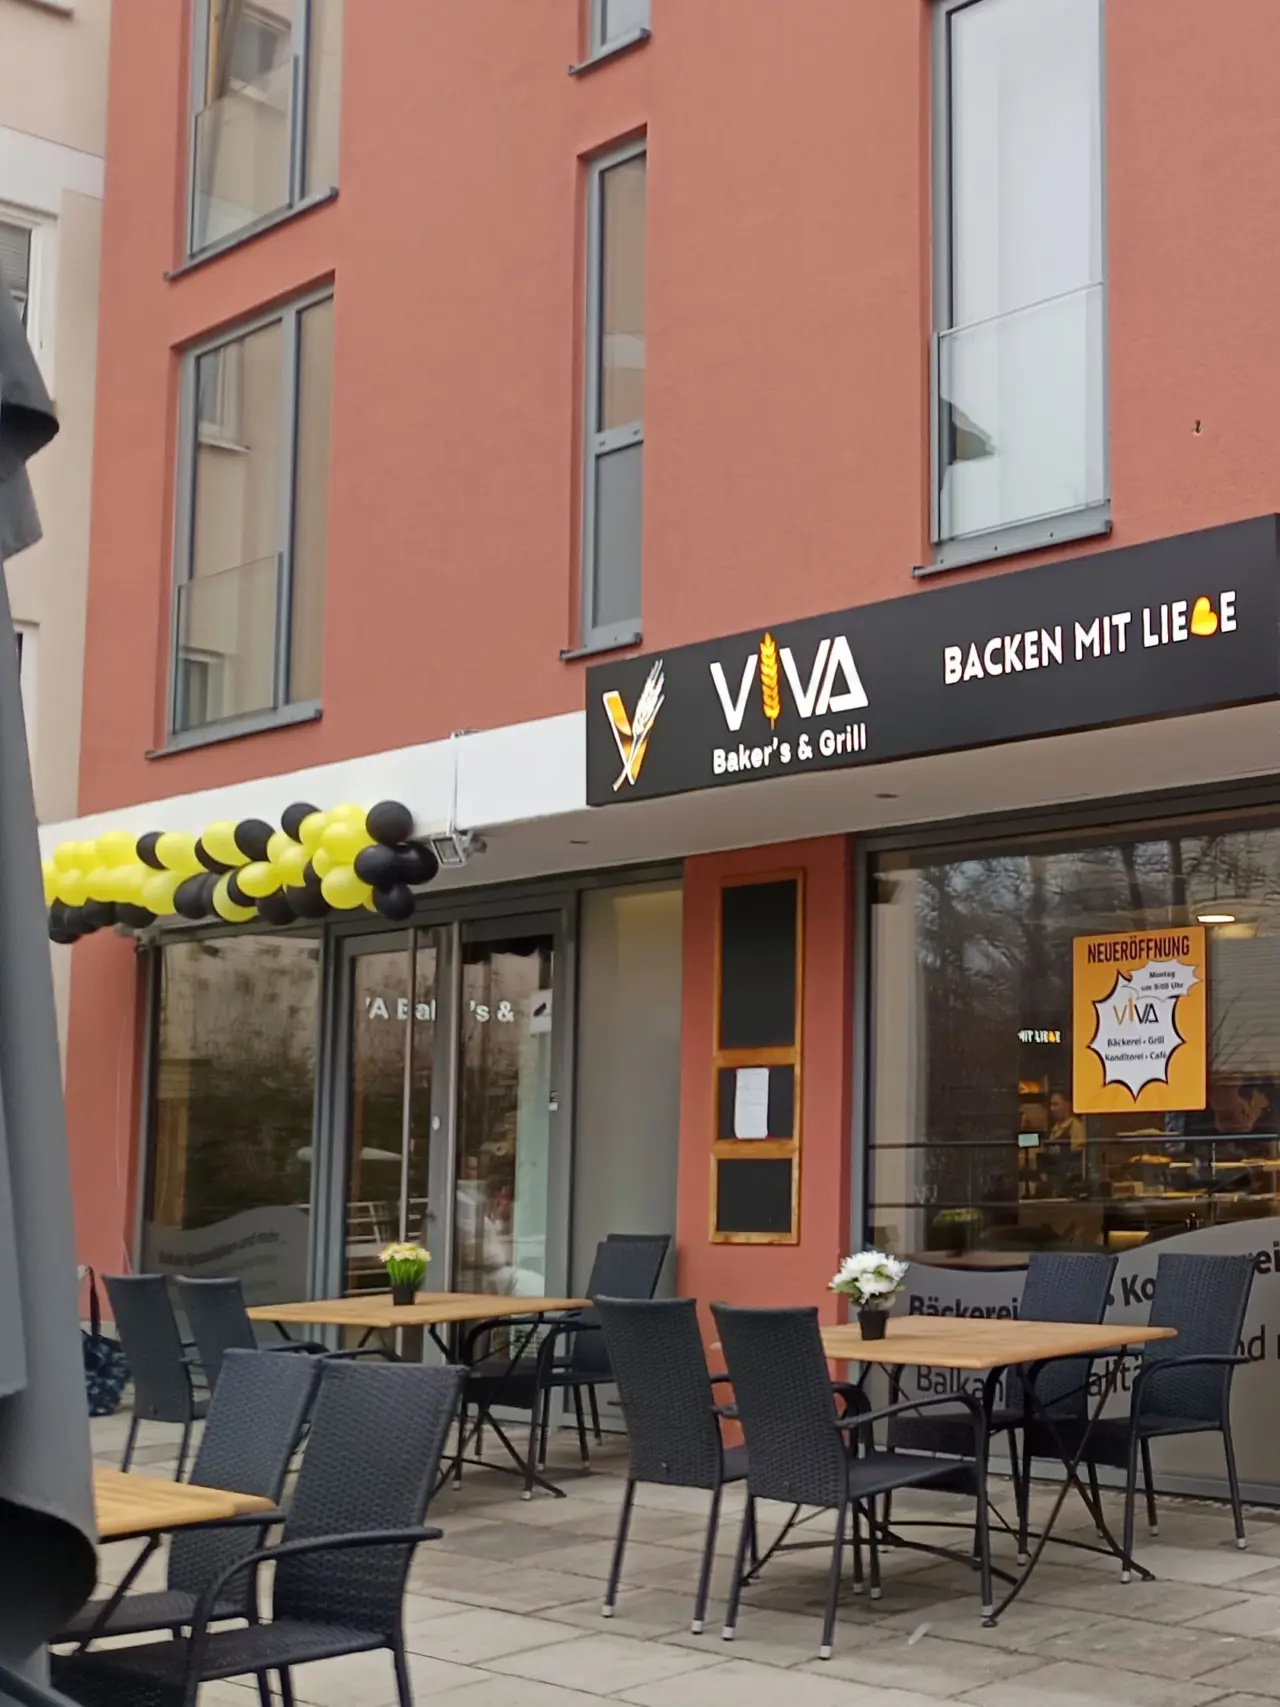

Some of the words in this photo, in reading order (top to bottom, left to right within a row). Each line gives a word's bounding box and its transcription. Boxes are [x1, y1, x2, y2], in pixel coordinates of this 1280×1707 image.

[944, 625, 1062, 685] BACKEN
[1074, 611, 1131, 660] MIT
[710, 631, 868, 732] VIVA
[713, 736, 791, 774] Baker's
[797, 733, 813, 760] &
[819, 722, 866, 756] Grill
[1087, 935, 1190, 964] NEUERÖFFNUNG
[1149, 971, 1176, 980] Montag
[1113, 992, 1160, 1026] VIVA
[1148, 1035, 1165, 1046] Grill
